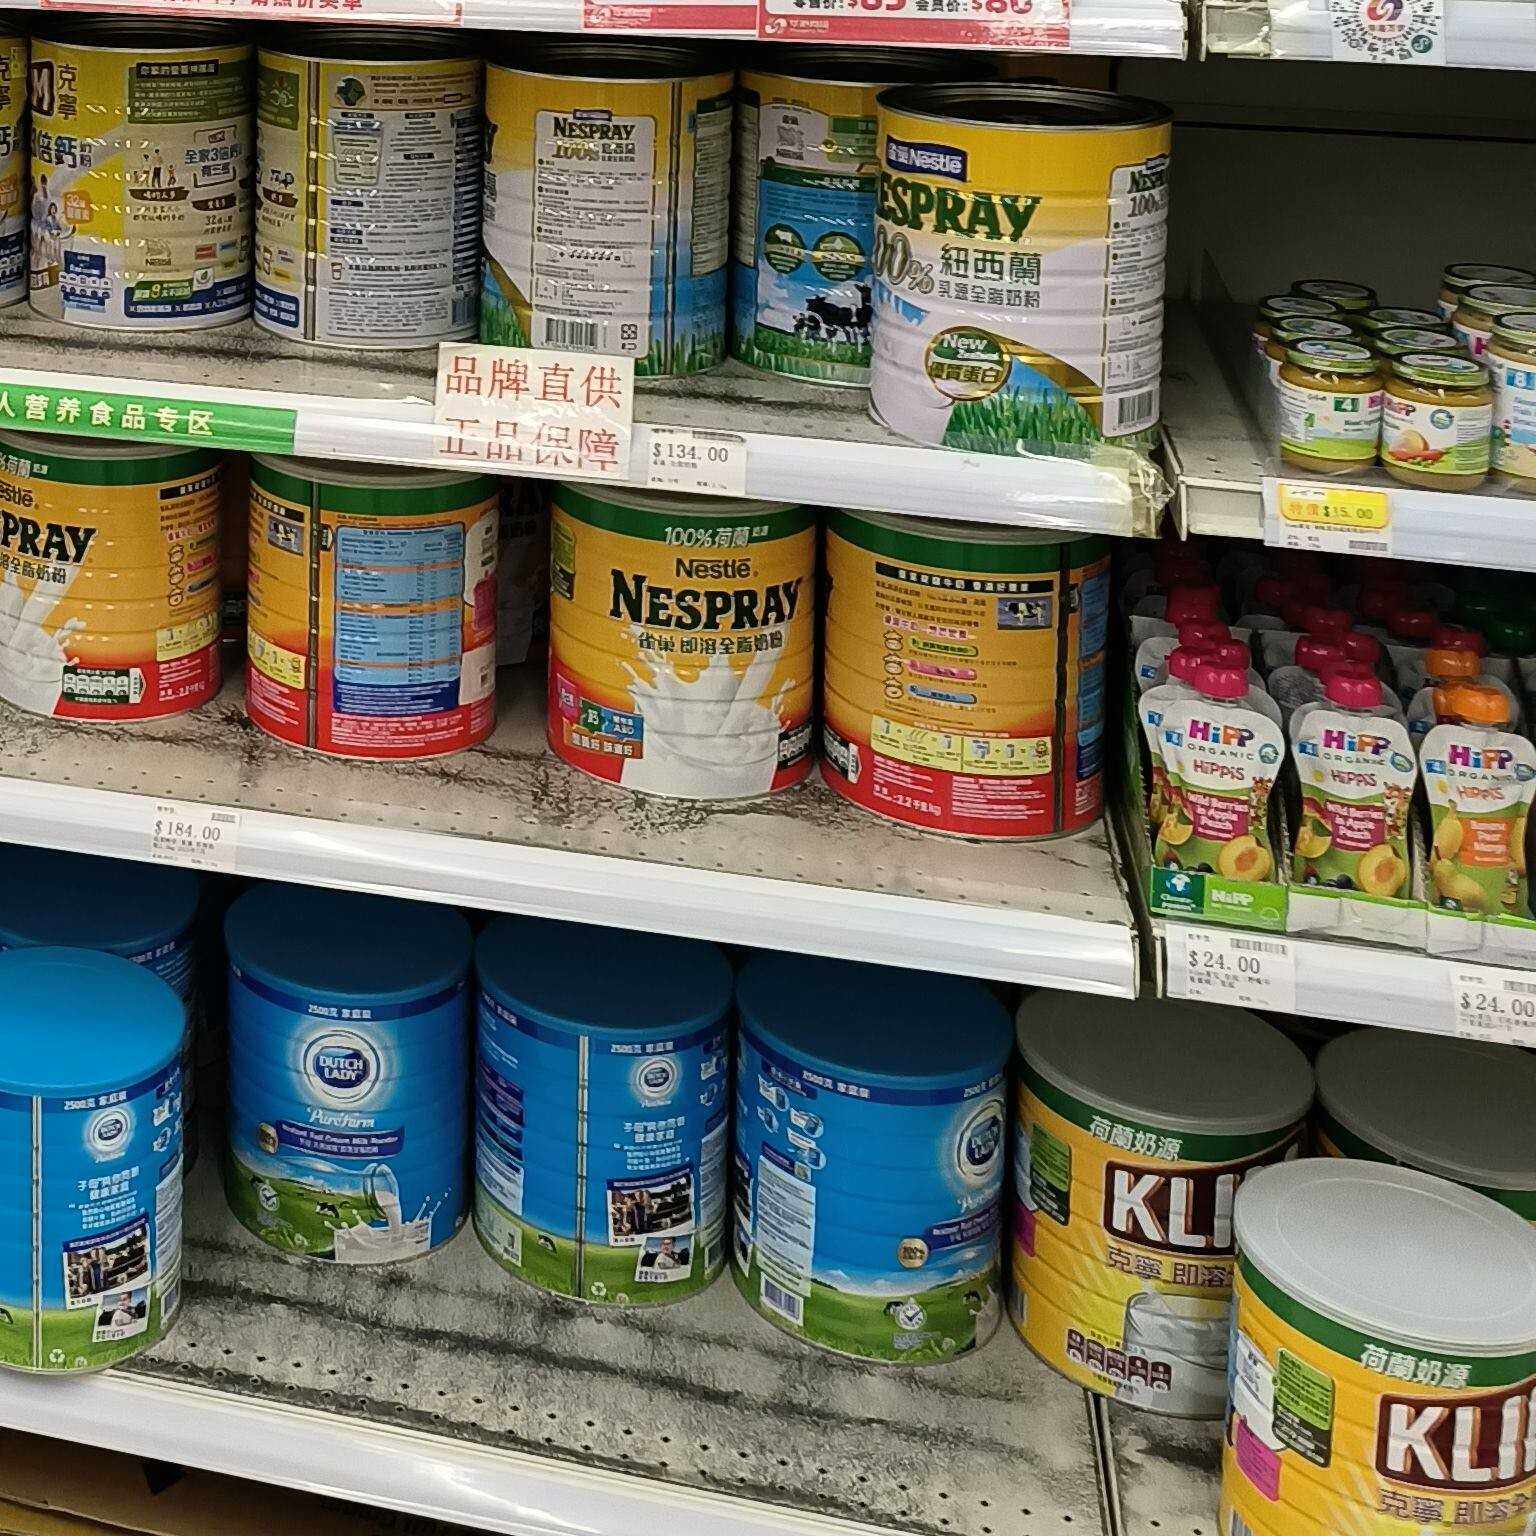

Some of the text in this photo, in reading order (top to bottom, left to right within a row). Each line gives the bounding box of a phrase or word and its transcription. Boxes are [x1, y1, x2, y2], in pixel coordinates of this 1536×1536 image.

[553, 117, 635, 141] NESPRAY
[939, 242, 1042, 288] 紐西蘭
[445, 354, 623, 410] 品牌直供
[440, 416, 621, 474] 正品保障
[651, 441, 729, 464] $134.00
[676, 557, 752, 579] Nestlé
[610, 568, 804, 631] NESPRAY
[1189, 718, 1256, 748] HiPP
[1323, 729, 1392, 757] HiPP
[1187, 741, 1255, 761] ORGANIC
[1449, 743, 1514, 770] HiPP
[153, 818, 221, 843] $184.00
[1188, 949, 1261, 974] $24.00
[1459, 992, 1536, 1018] $24.00
[319, 1054, 364, 1070] DUTCH
[324, 1068, 358, 1081] LADY
[1089, 1114, 1184, 1162] 荷蘭奶源
[1360, 1343, 1473, 1388] 荷蘭奶源
[1385, 1392, 1536, 1483] KLI
